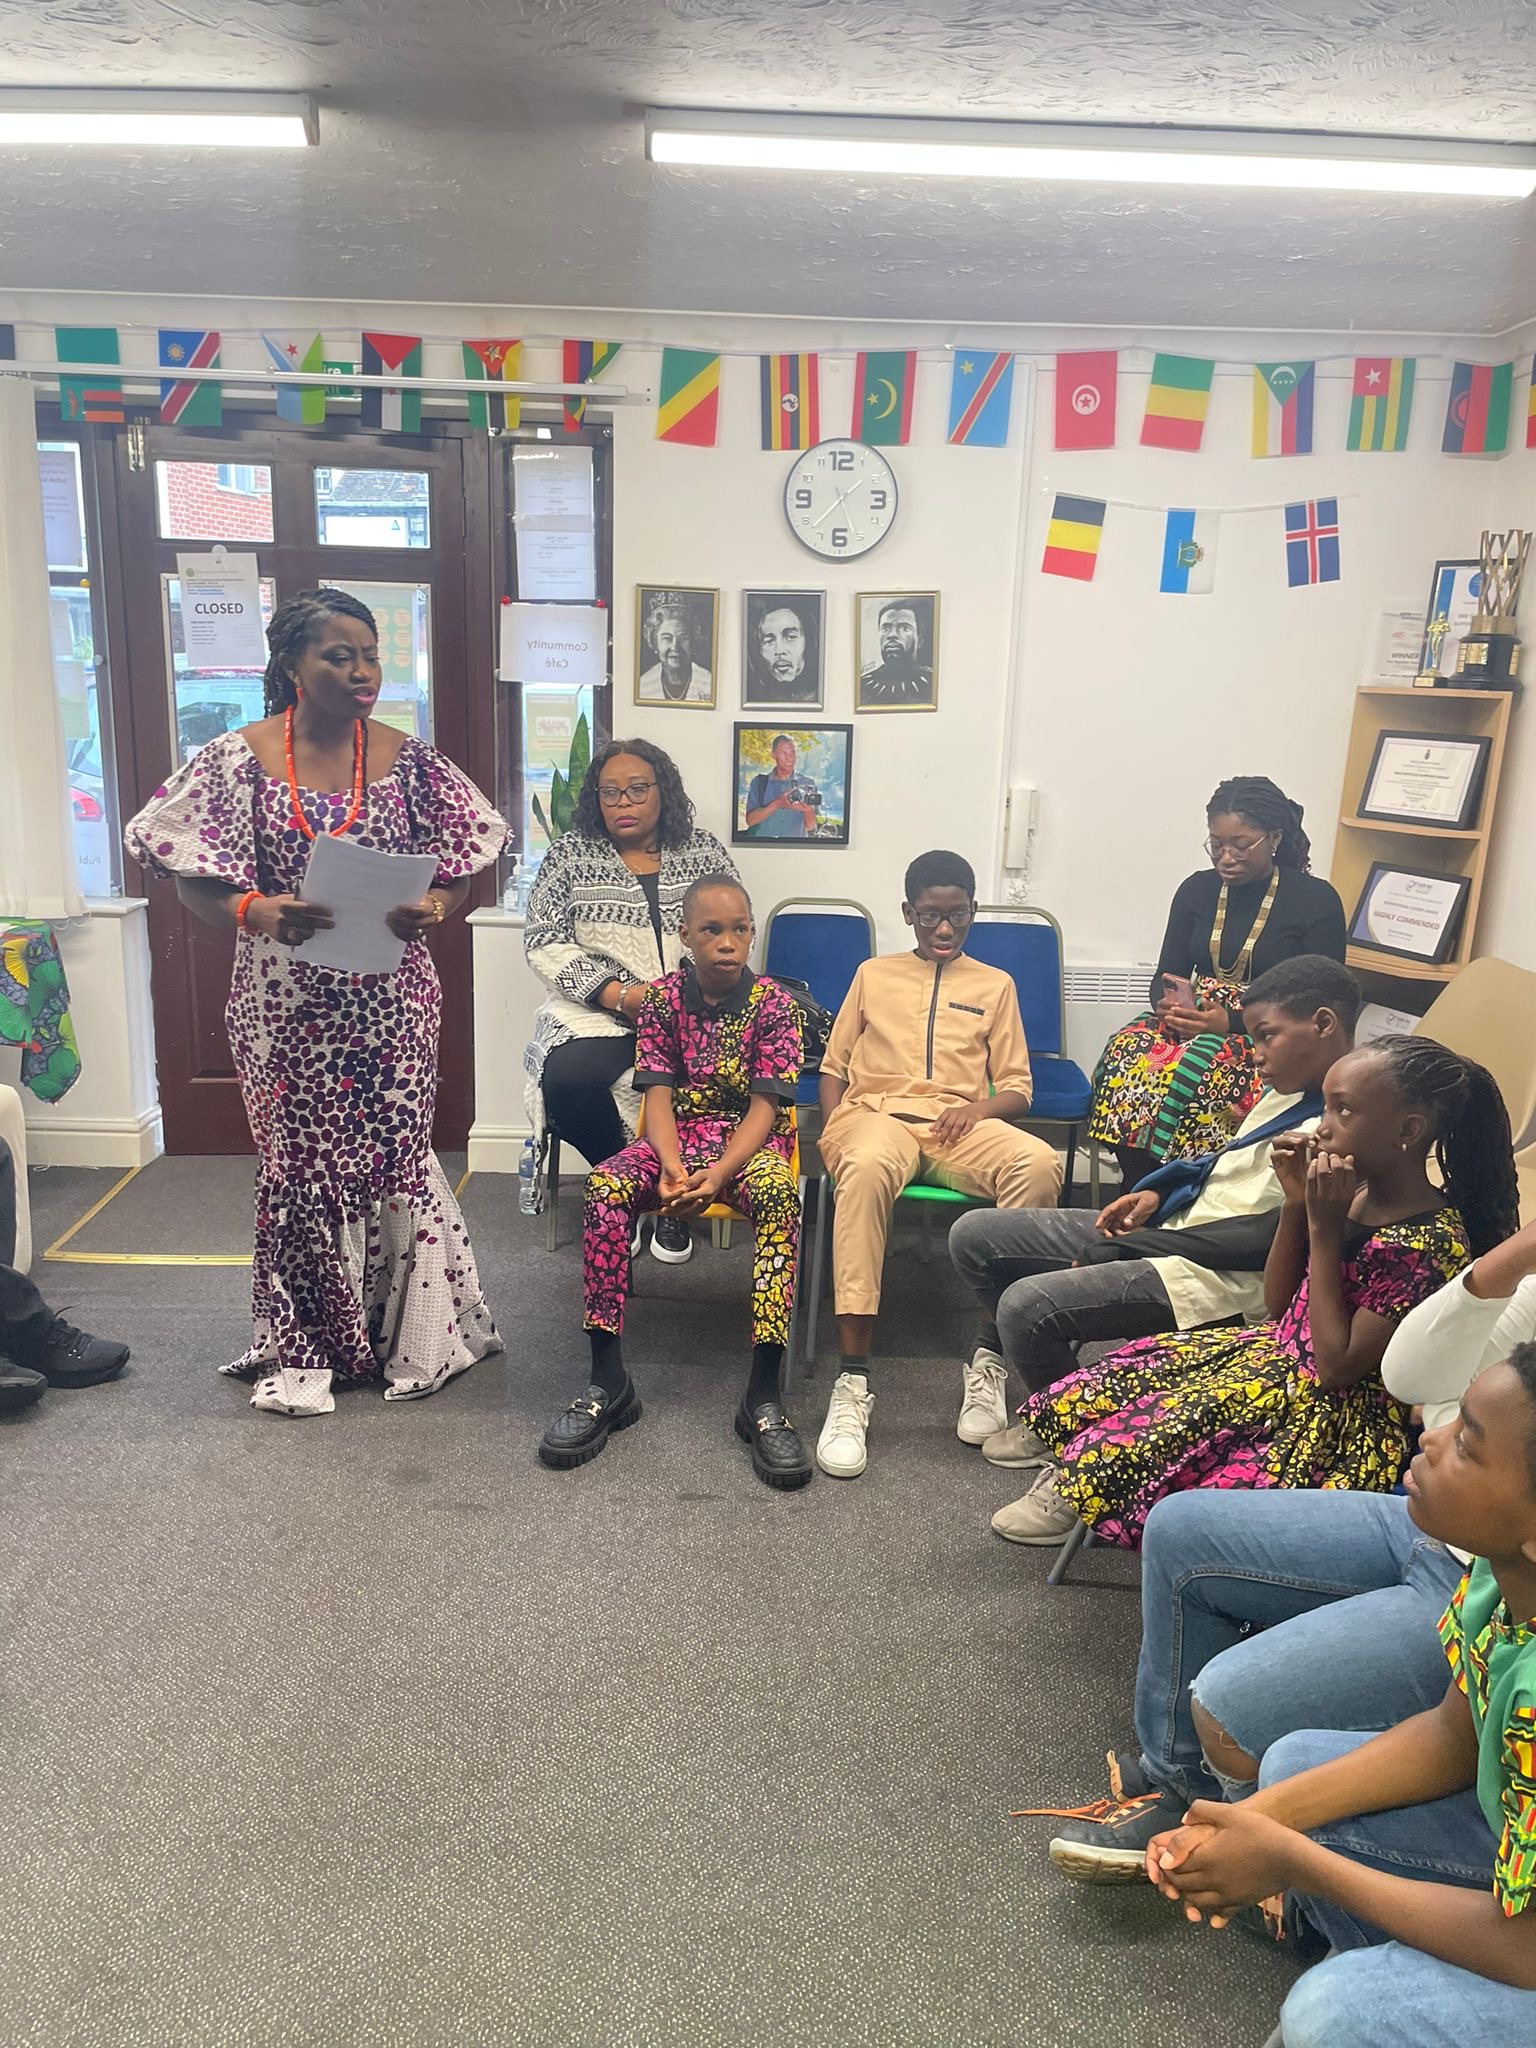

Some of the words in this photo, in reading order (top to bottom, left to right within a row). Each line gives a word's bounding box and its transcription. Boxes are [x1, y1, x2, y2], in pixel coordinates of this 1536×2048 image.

[828, 450, 855, 471] 12
[795, 489, 812, 509] 9
[870, 490, 887, 510] 3
[831, 527, 848, 548] 6
[194, 602, 244, 615] CLOSED
[1373, 910, 1397, 921] HIGHLY
[1397, 915, 1441, 930] COMMENDED
